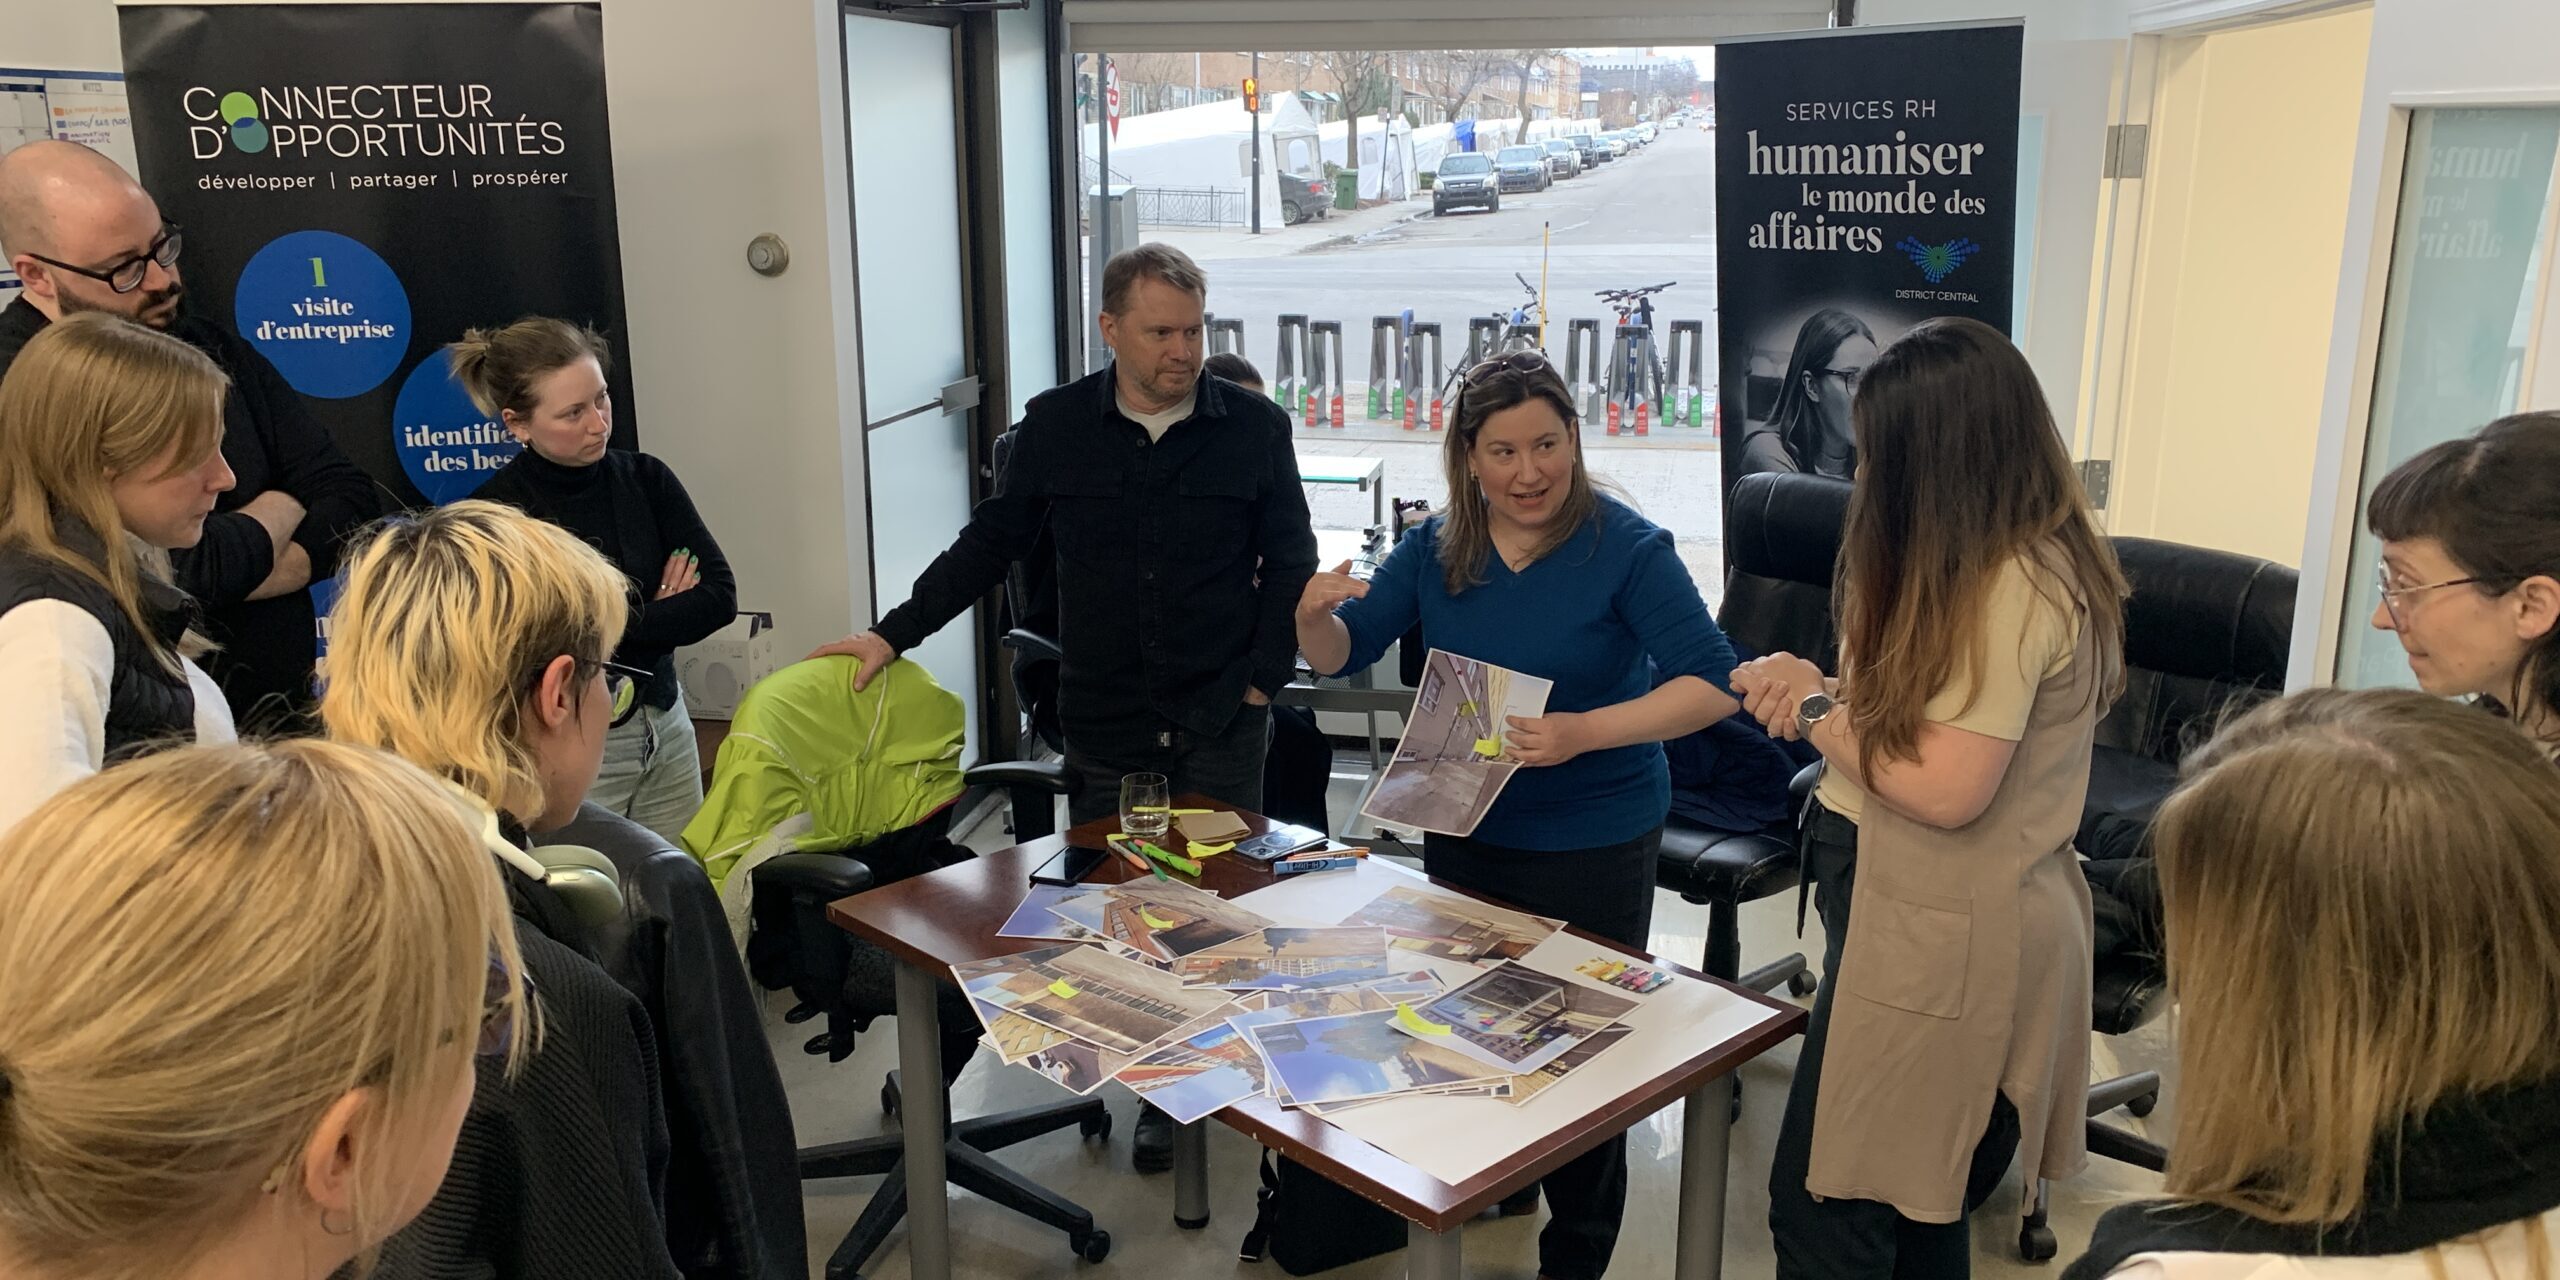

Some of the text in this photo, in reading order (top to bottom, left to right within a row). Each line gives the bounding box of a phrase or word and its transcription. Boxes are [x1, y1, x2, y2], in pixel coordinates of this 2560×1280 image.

[1786, 99, 1936, 122] SERVICES RH
[1747, 129, 1985, 176] humaniser
[198, 169, 568, 191] développer partager prospérer
[1801, 179, 1986, 215] le monde des
[1748, 210, 1883, 254] affaires
[307, 257, 328, 287] 1
[291, 296, 355, 317] visite
[1895, 289, 1979, 303] DISTRICT CENTRAL
[256, 319, 395, 344] d'entreprise
[404, 421, 521, 448] identifie
[424, 450, 468, 473] des
